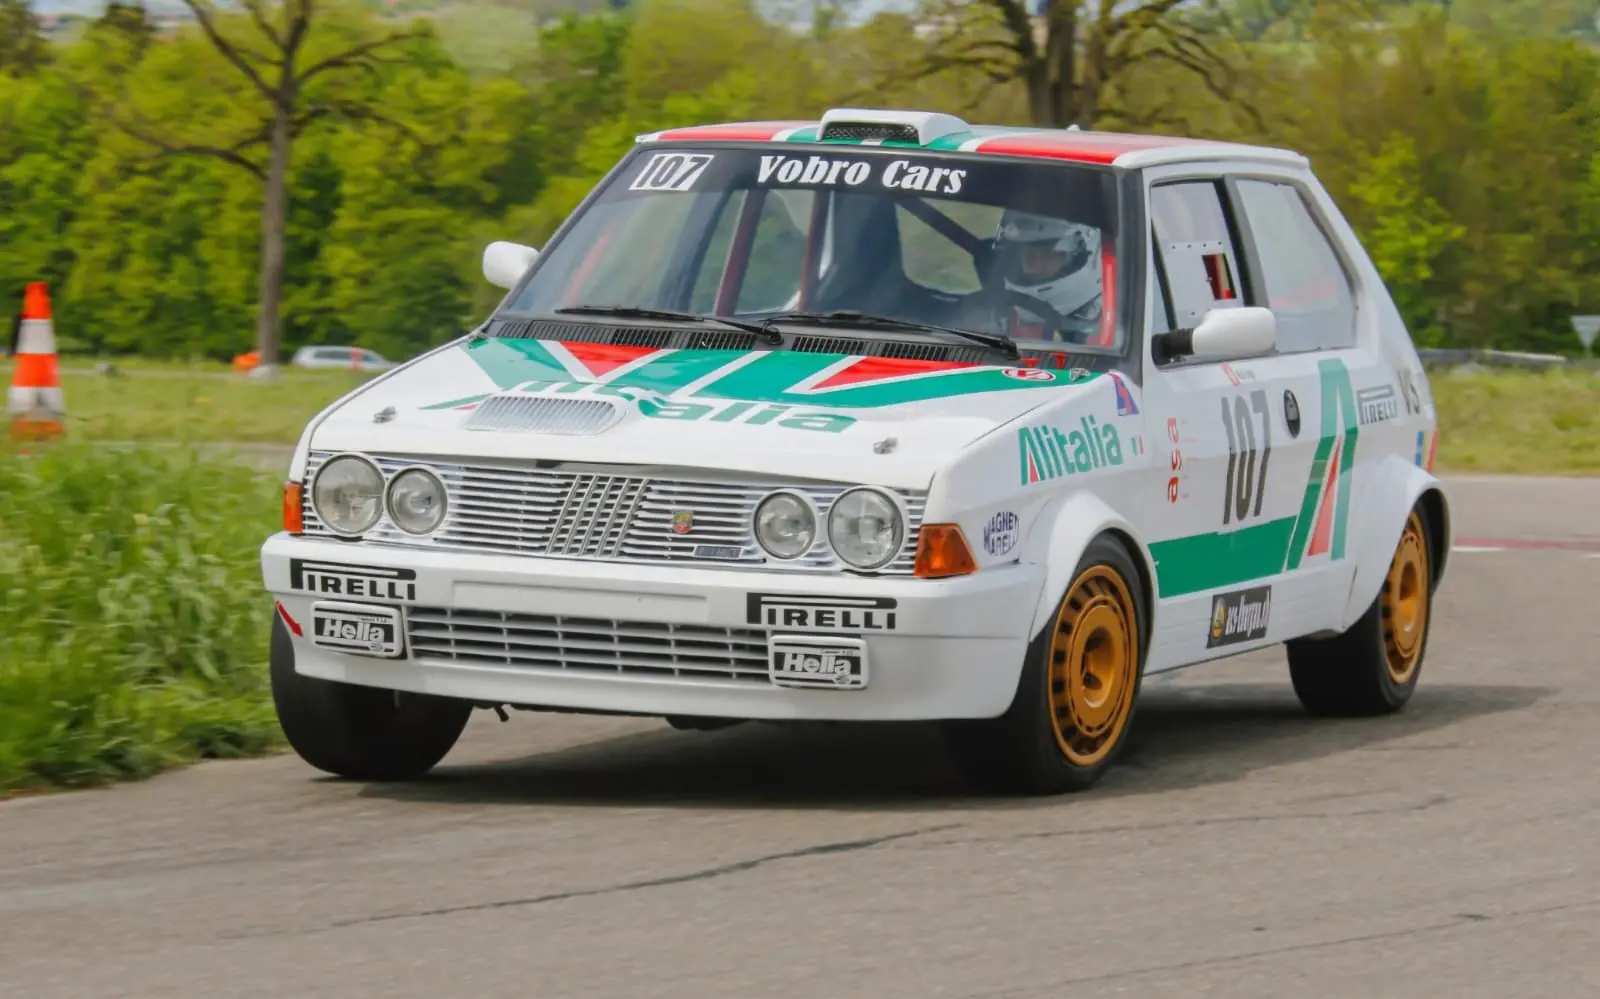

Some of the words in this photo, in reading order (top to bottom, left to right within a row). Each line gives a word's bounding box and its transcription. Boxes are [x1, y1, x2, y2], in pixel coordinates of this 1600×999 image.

[636, 154, 708, 190] 107
[757, 155, 870, 185] Vobro
[882, 160, 966, 194] Cars
[1356, 379, 1398, 426] PIRELLI
[1018, 414, 1124, 486] Alitalia
[1221, 389, 1271, 526] 107
[290, 558, 416, 601] PIRELLI
[322, 617, 385, 643] Hella
[746, 592, 898, 630] PIRELLI
[783, 651, 852, 676] Hella
